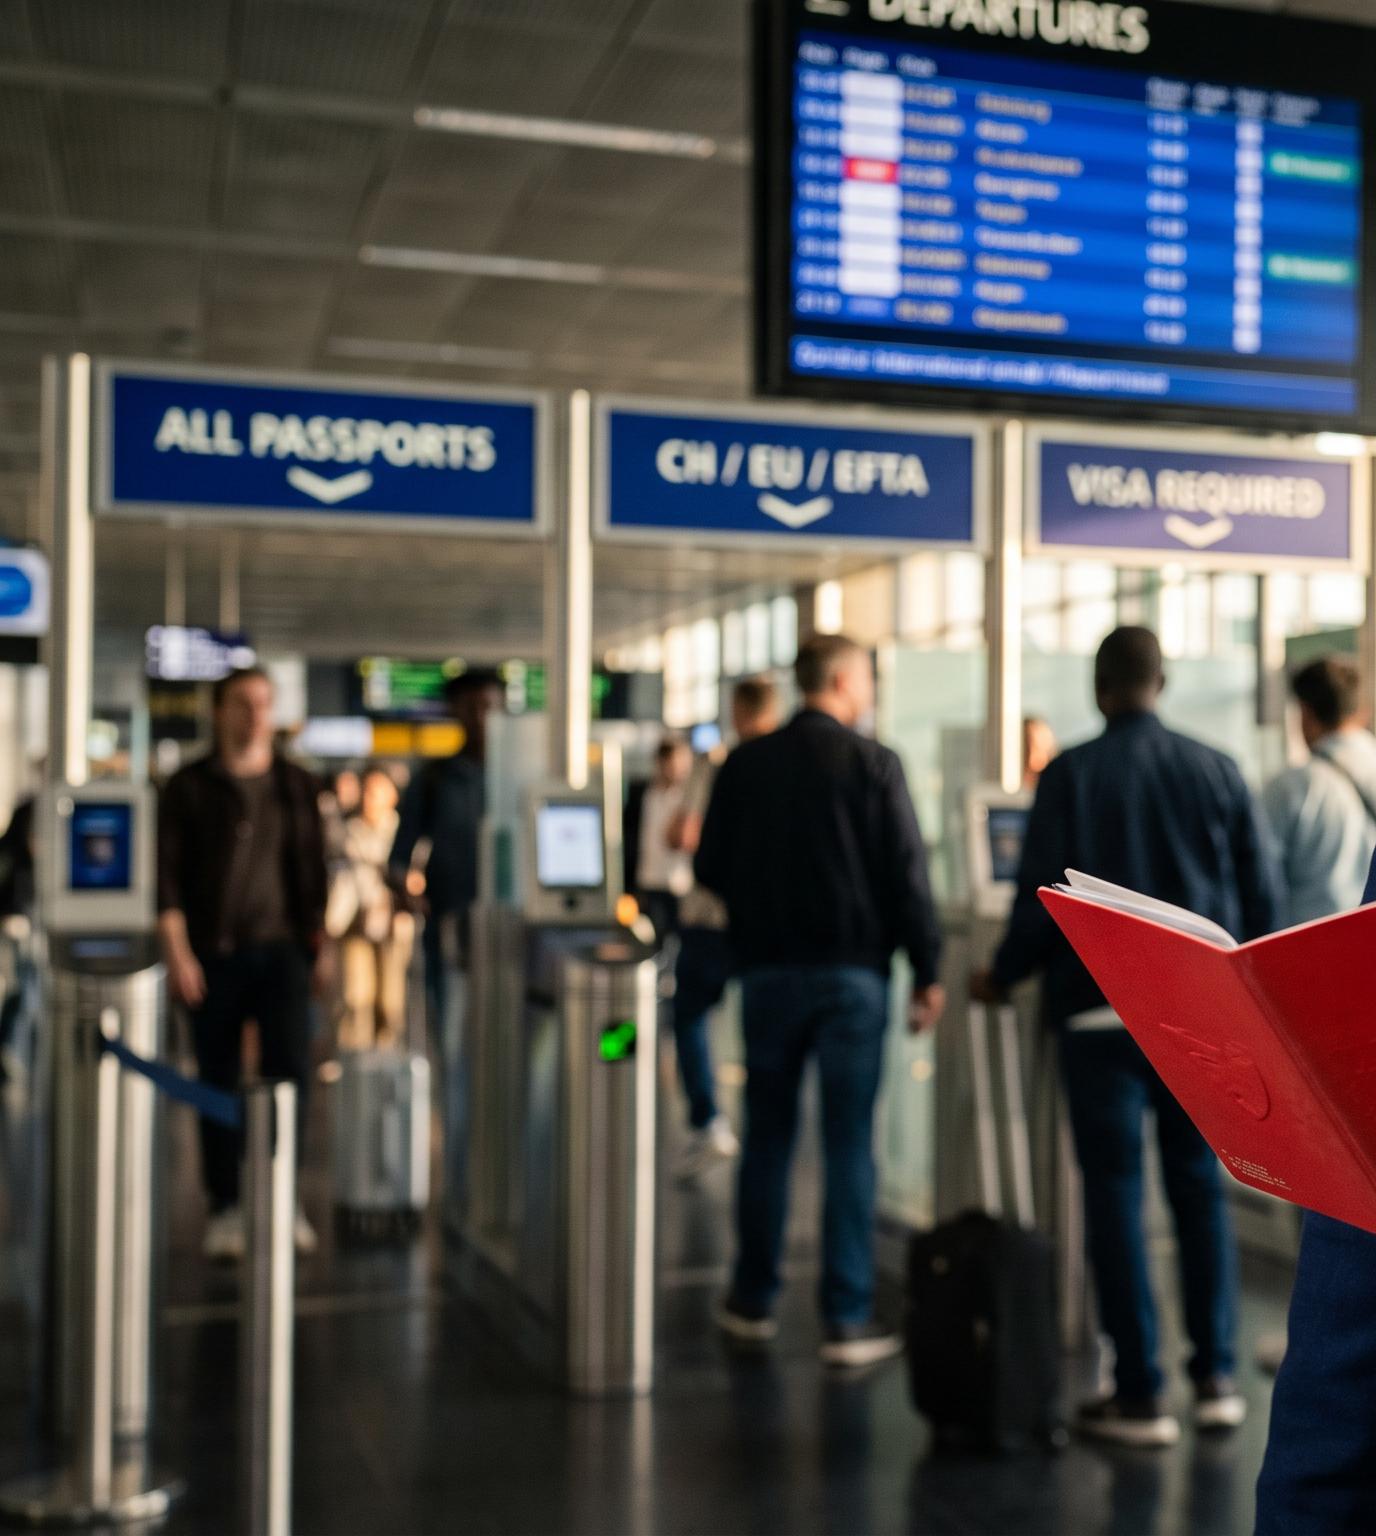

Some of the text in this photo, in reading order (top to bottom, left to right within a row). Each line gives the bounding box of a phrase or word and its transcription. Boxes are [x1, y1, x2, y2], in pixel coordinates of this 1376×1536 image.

[154, 407, 497, 472] ALL PASSPORTS
[655, 438, 929, 498] CH / EU / EFTA
[1066, 463, 1325, 521] VISA REQUIRED
